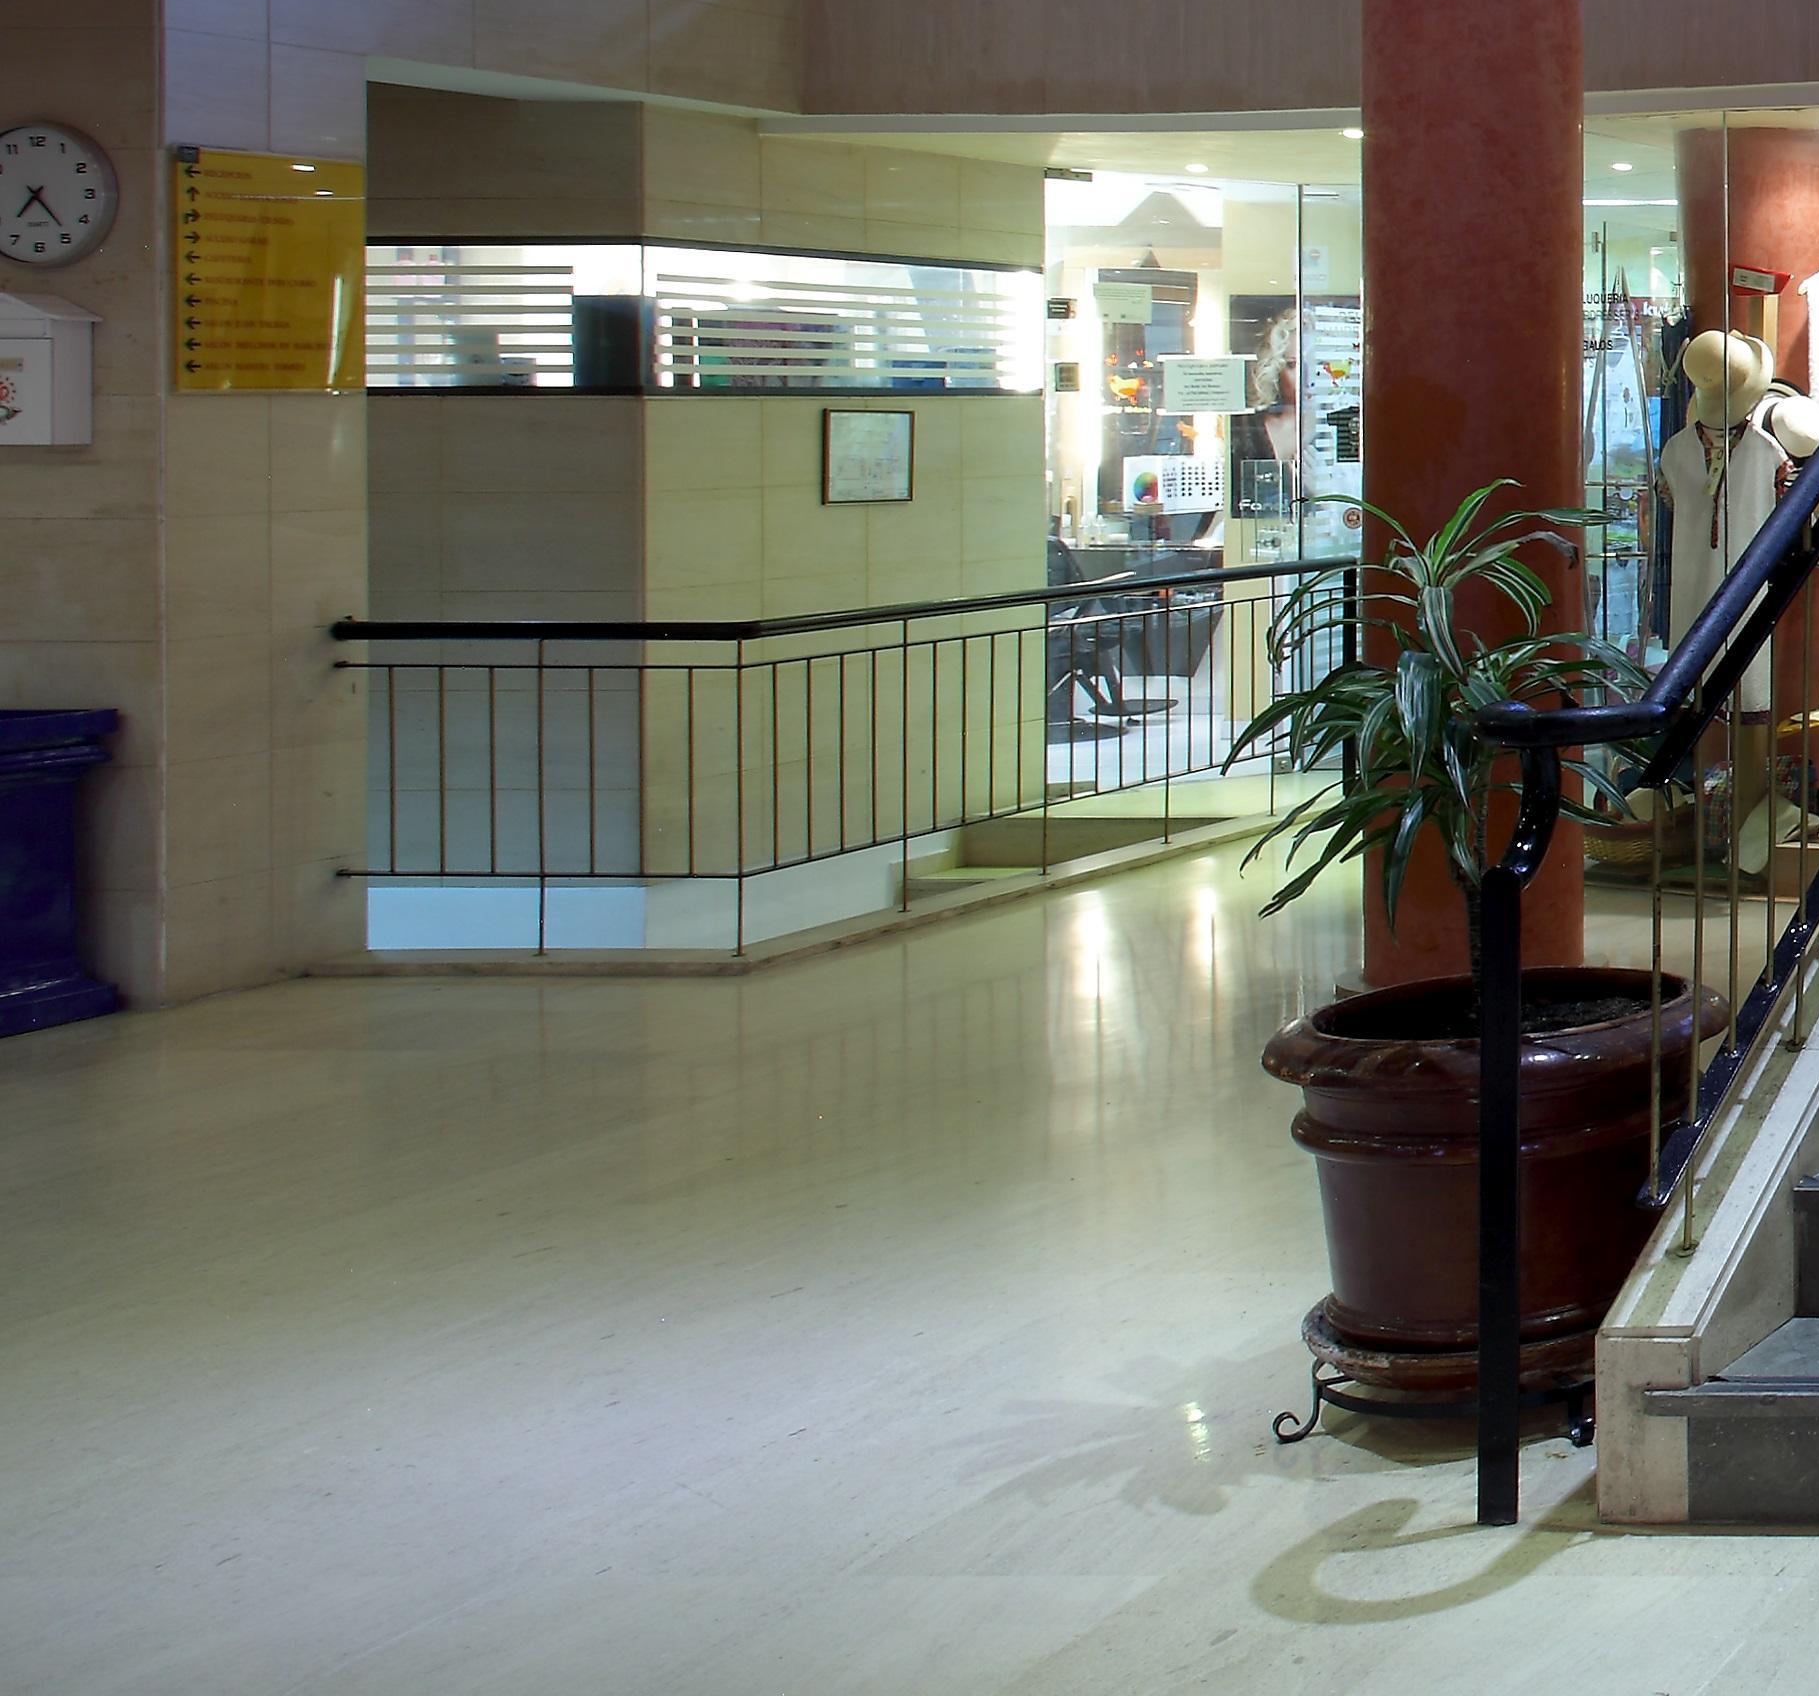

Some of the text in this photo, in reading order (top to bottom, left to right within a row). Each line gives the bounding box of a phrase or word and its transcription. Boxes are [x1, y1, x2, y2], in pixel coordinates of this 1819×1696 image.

[29, 136, 46, 147] 12
[6, 144, 19, 155] 11
[60, 142, 66, 154] 1
[76, 162, 87, 174] 2
[84, 188, 96, 200] 3
[78, 214, 90, 224] 4
[10, 234, 20, 245] 7
[60, 233, 72, 244] 5
[34, 242, 46, 253] 6
